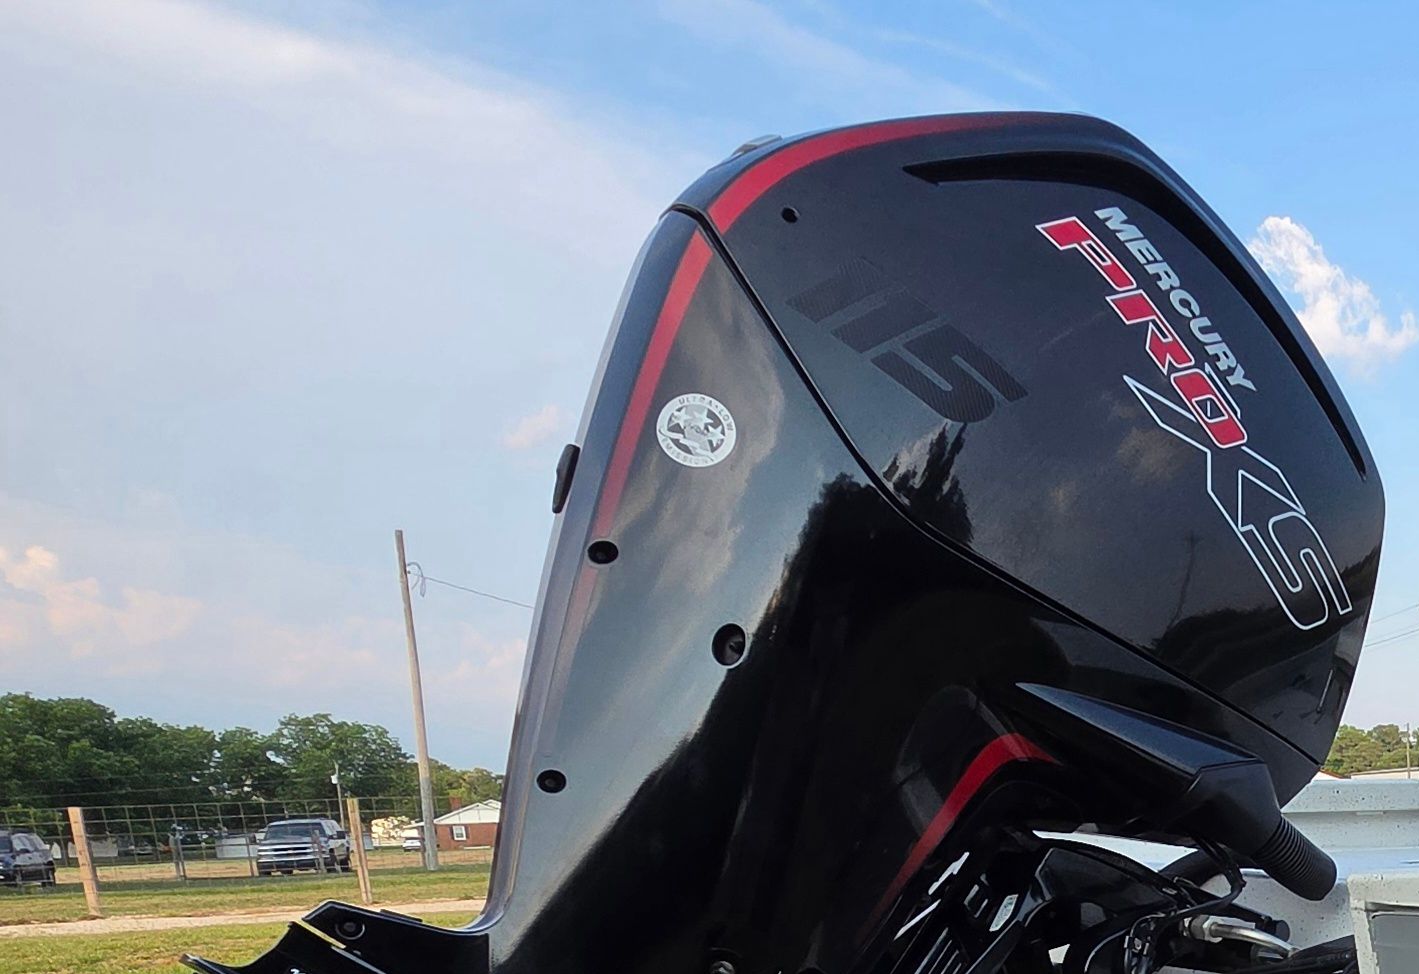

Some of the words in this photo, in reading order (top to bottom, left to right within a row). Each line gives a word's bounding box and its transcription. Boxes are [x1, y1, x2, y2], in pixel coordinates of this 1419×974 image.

[784, 257, 1030, 424] 115
[1035, 216, 1248, 448] PRO
[1094, 206, 1257, 391] MERCURY
[1123, 363, 1352, 630] XS
